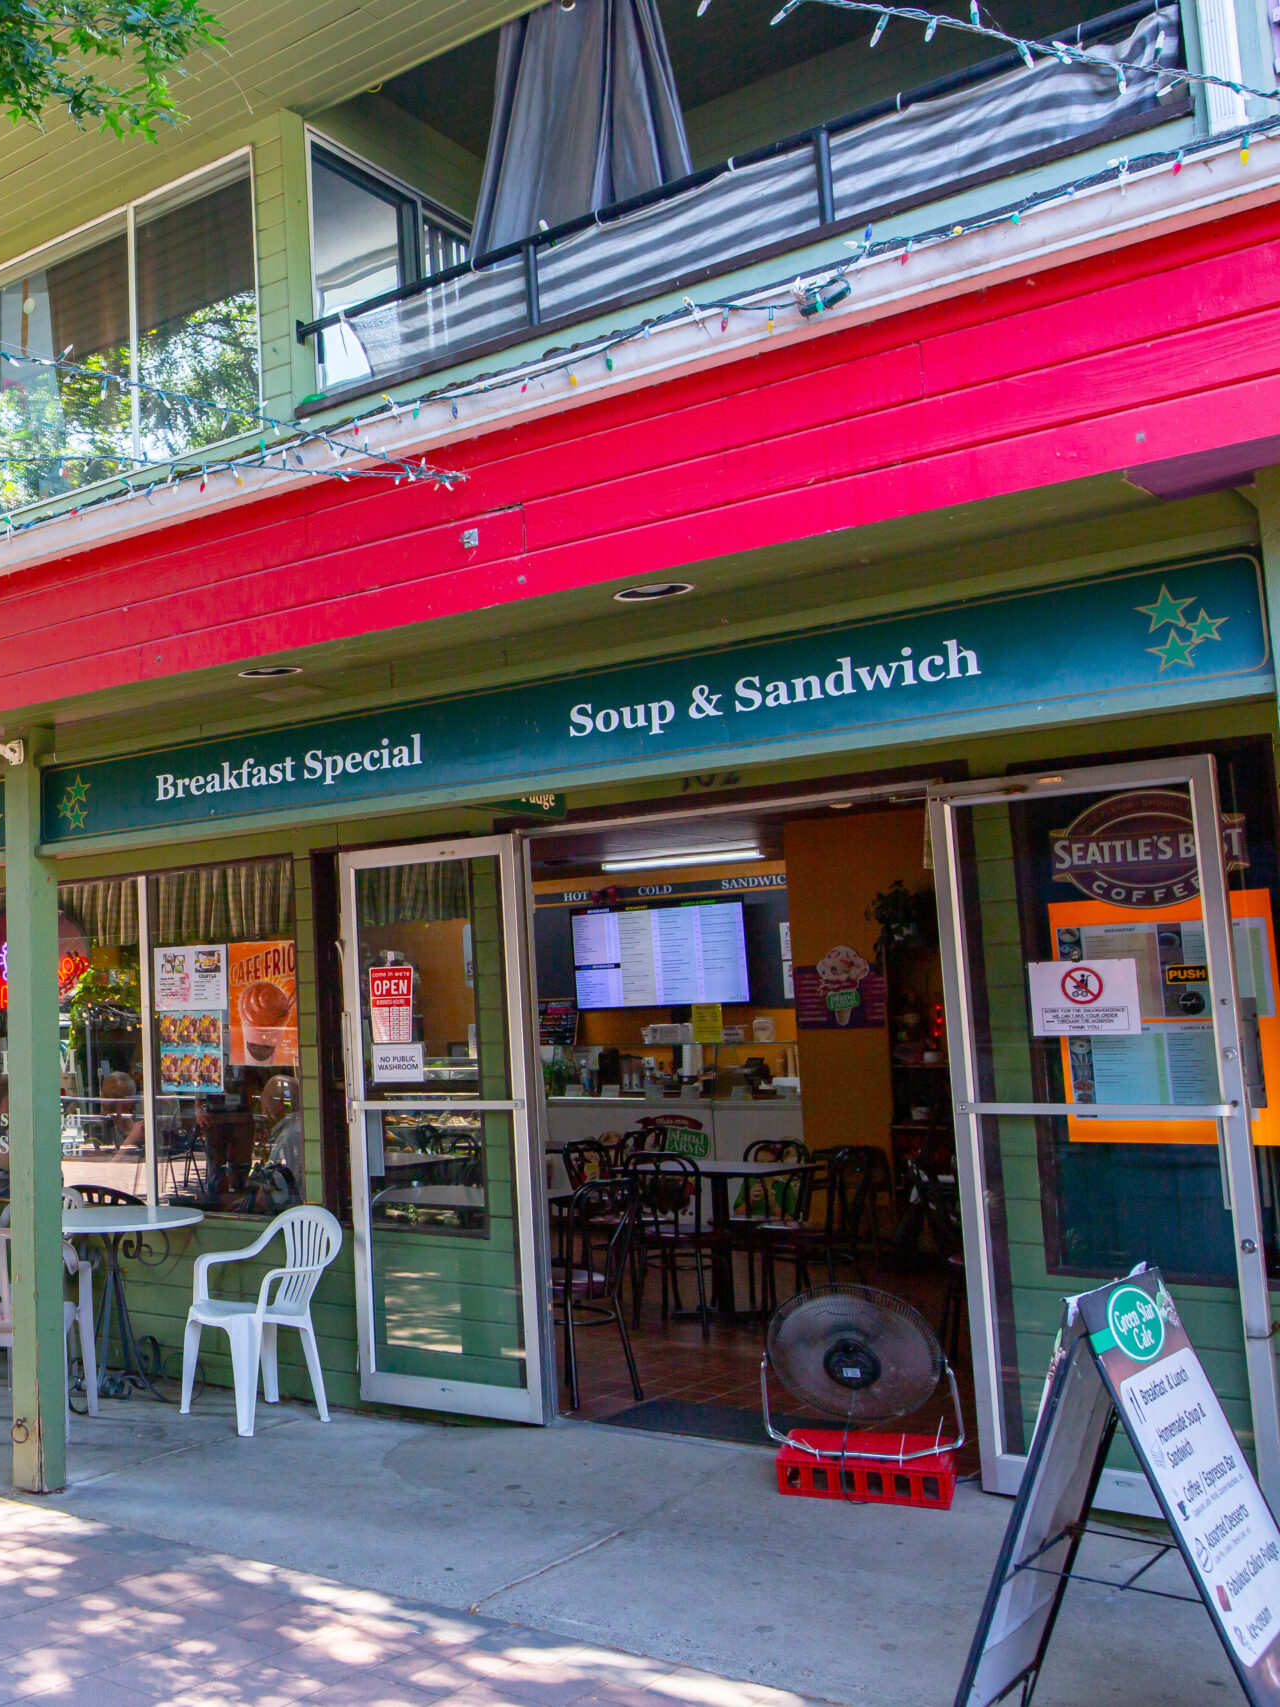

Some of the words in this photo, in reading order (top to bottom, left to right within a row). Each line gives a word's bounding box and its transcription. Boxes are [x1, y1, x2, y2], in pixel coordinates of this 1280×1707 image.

[569, 700, 675, 738] Soup
[688, 685, 724, 718] &
[735, 639, 982, 713] Sandwich
[155, 752, 296, 801] Breakfast
[304, 734, 423, 785] Special
[1054, 835, 1173, 869] SEATTLE'S
[1179, 828, 1242, 858] BT
[564, 891, 589, 902] HOT
[638, 884, 672, 896] COLD
[230, 953, 261, 986] CAFE
[264, 943, 295, 977] FRIO
[1168, 969, 1206, 980] PUSH
[374, 979, 408, 996] OPEN
[1114, 1310, 1141, 1336] Green
[1136, 1301, 1156, 1323] Star
[1133, 1324, 1155, 1350] Cafe
[1139, 1379, 1169, 1406] Breakfast
[1165, 1374, 1174, 1391] &
[1169, 1366, 1190, 1388] Lunch
[1155, 1413, 1189, 1446] Homemade
[1183, 1408, 1203, 1426] Soup
[1166, 1437, 1195, 1469] Sandwich
[1183, 1479, 1203, 1503] Coffee
[1202, 1461, 1228, 1489] Espresso
[1222, 1454, 1237, 1472] Bar
[1204, 1518, 1229, 1551] Assorted
[1223, 1503, 1250, 1532] Desserts
[1226, 1566, 1252, 1600] Fabulous
[1246, 1553, 1266, 1578] Calico
[1259, 1539, 1280, 1564] Fudge
[1246, 1606, 1272, 1641] Ice-cream
